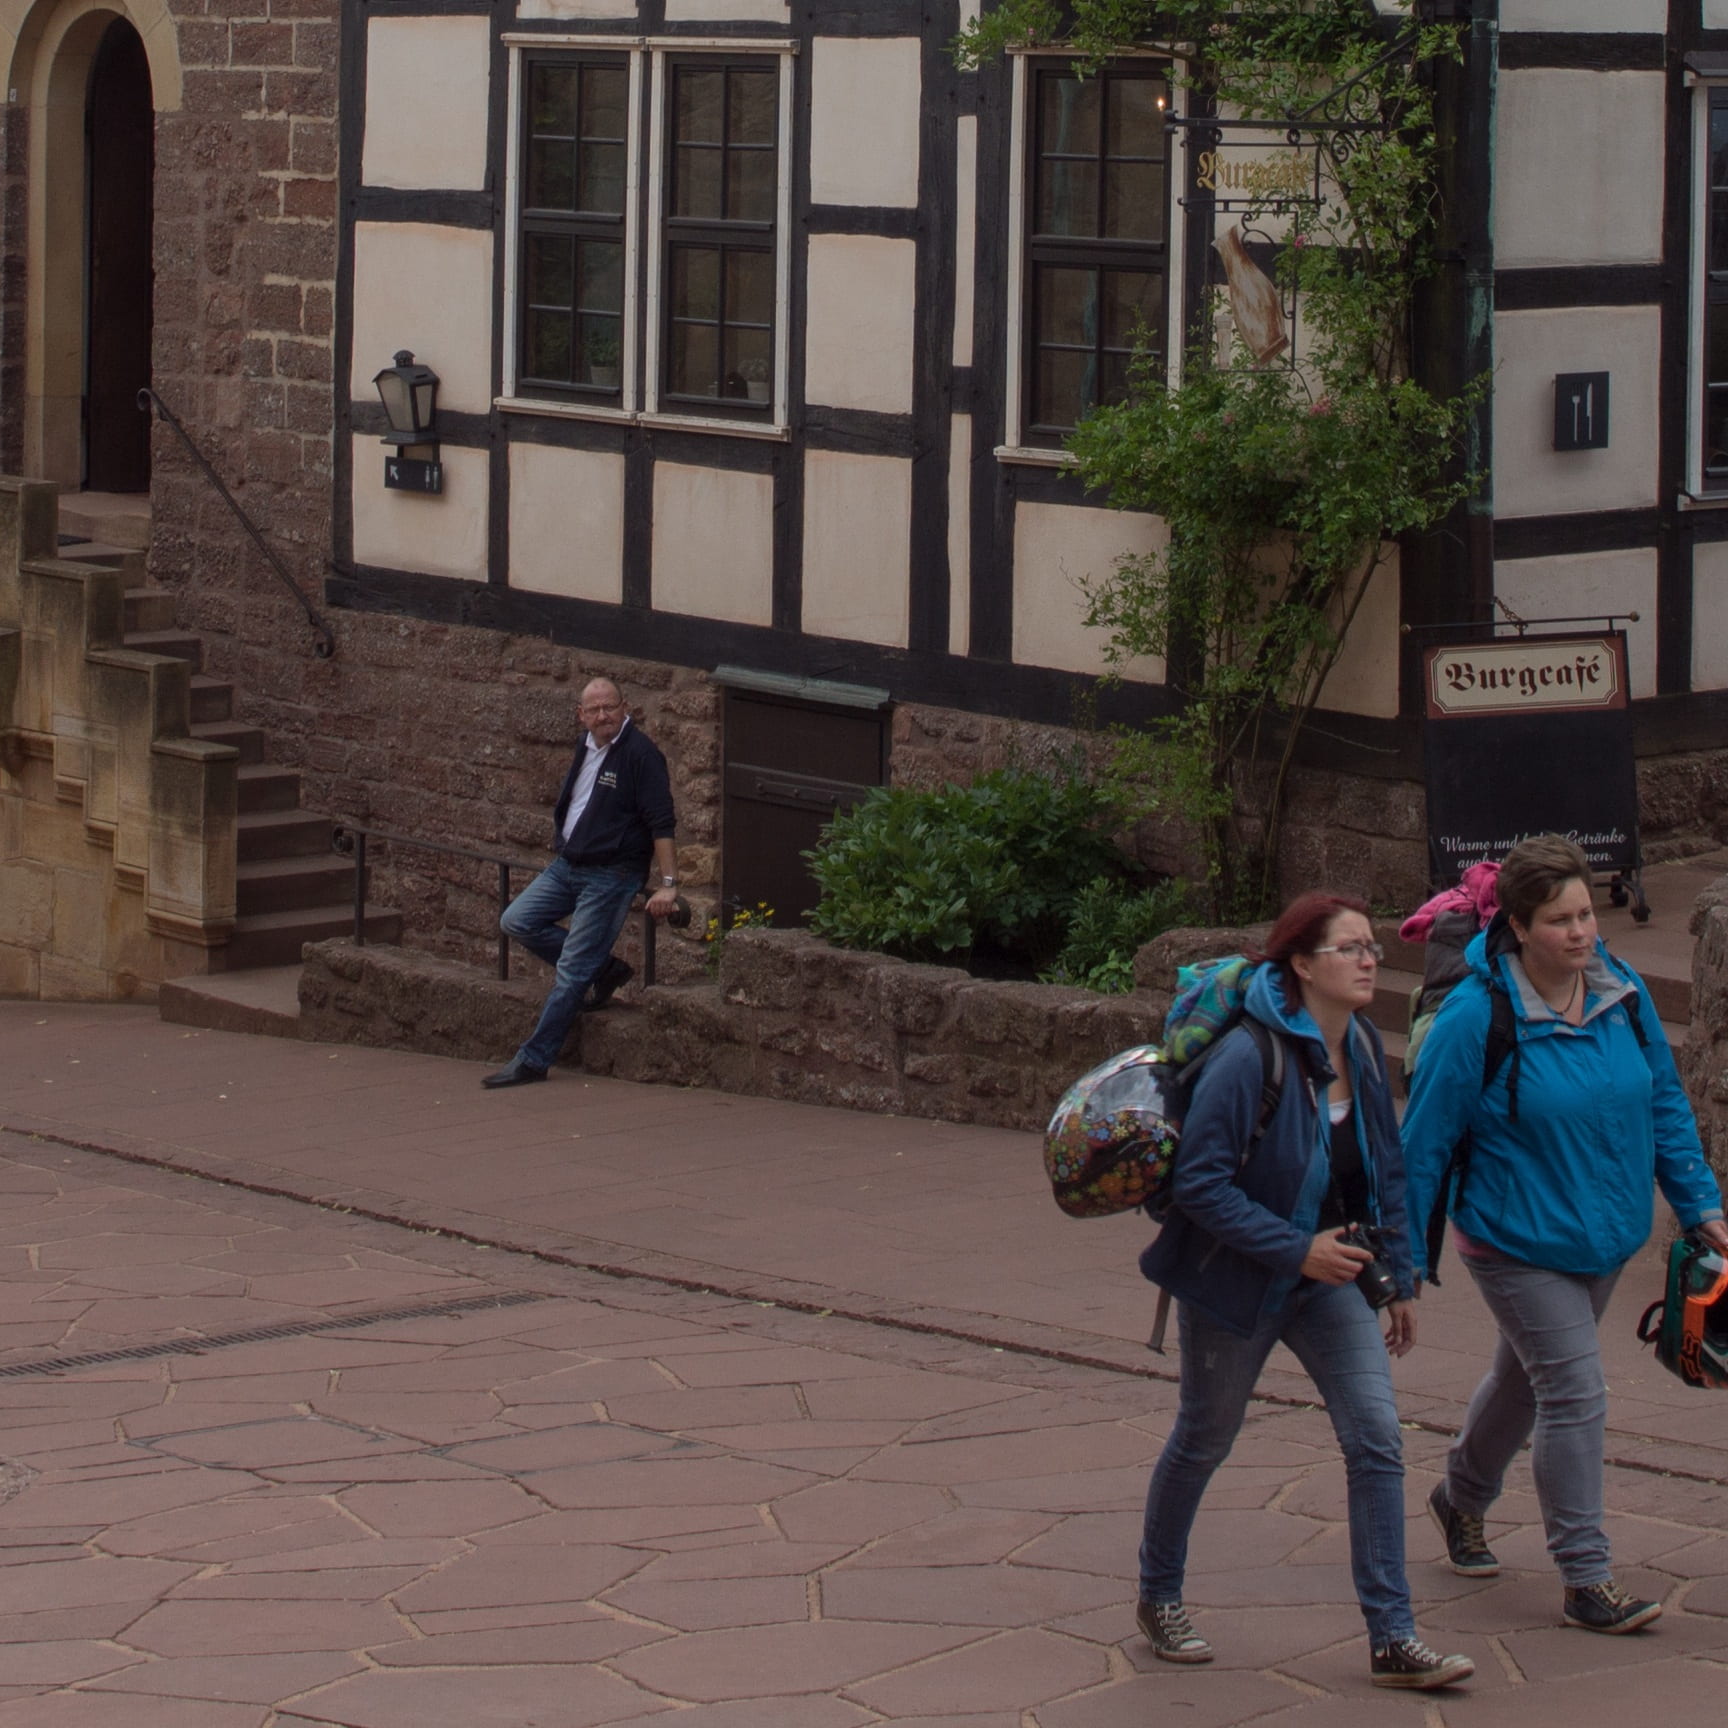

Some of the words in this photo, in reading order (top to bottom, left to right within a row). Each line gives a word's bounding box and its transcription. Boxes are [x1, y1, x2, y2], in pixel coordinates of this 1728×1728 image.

[1445, 655, 1600, 696] Burgcafé
[1440, 836, 1491, 852] Warme
[1494, 833, 1518, 849] und
